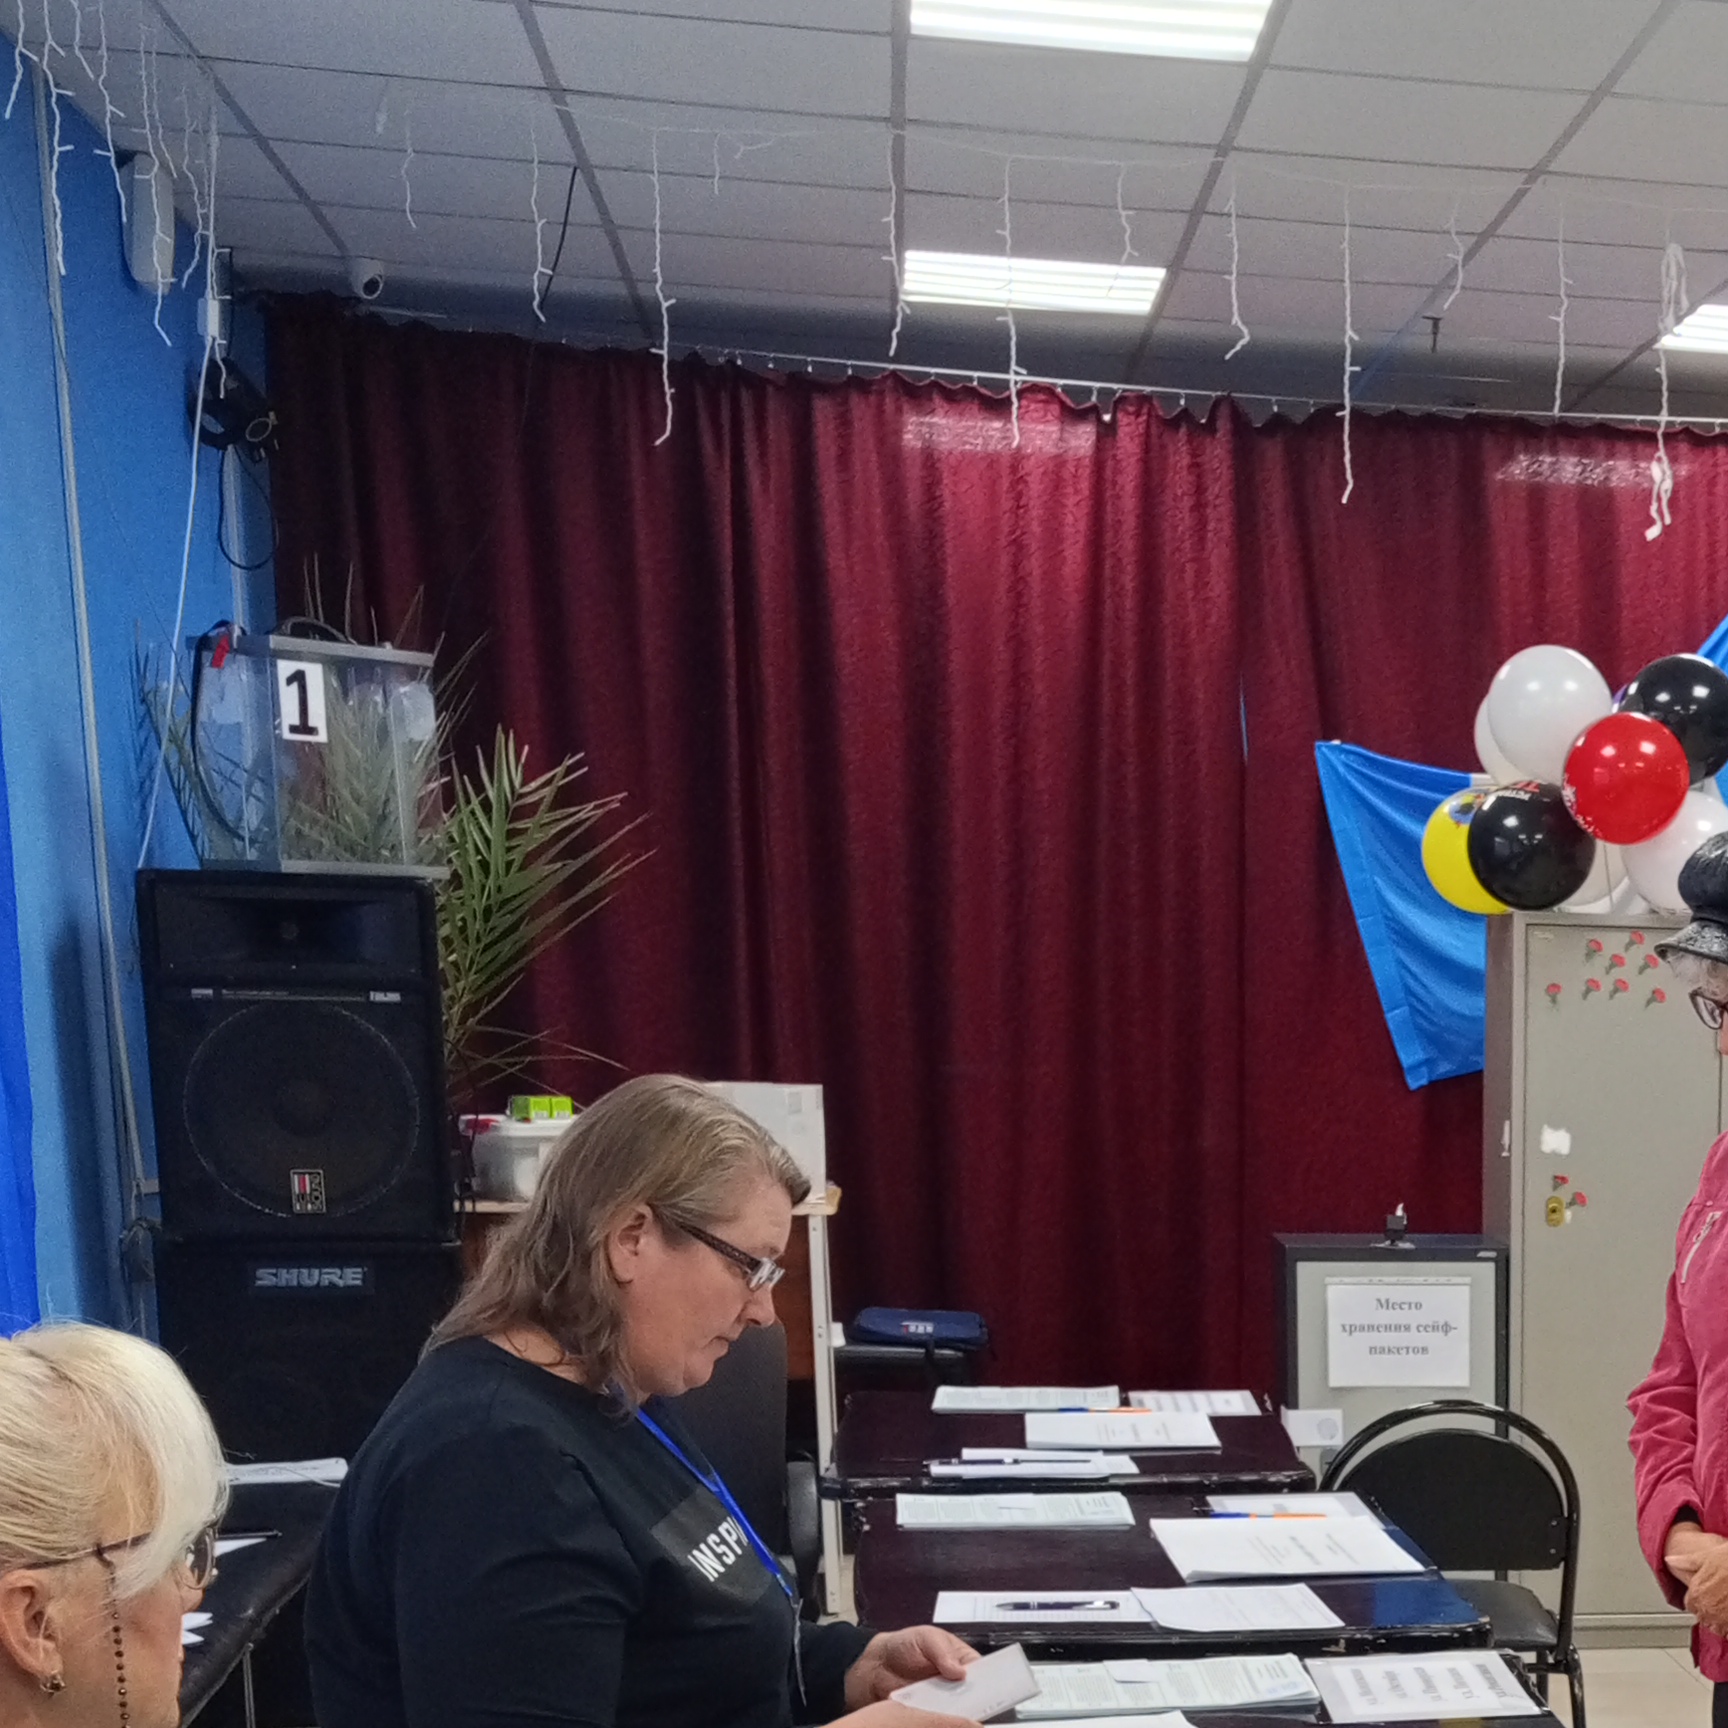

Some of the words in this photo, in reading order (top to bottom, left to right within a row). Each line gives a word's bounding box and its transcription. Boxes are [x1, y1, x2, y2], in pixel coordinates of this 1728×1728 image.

[285, 668, 319, 736] 1
[254, 1267, 363, 1288] SHURE
[1375, 1297, 1423, 1311] Место
[1340, 1322, 1411, 1337] хранения
[1416, 1320, 1459, 1337] сейф-
[1368, 1344, 1430, 1356] пакетов
